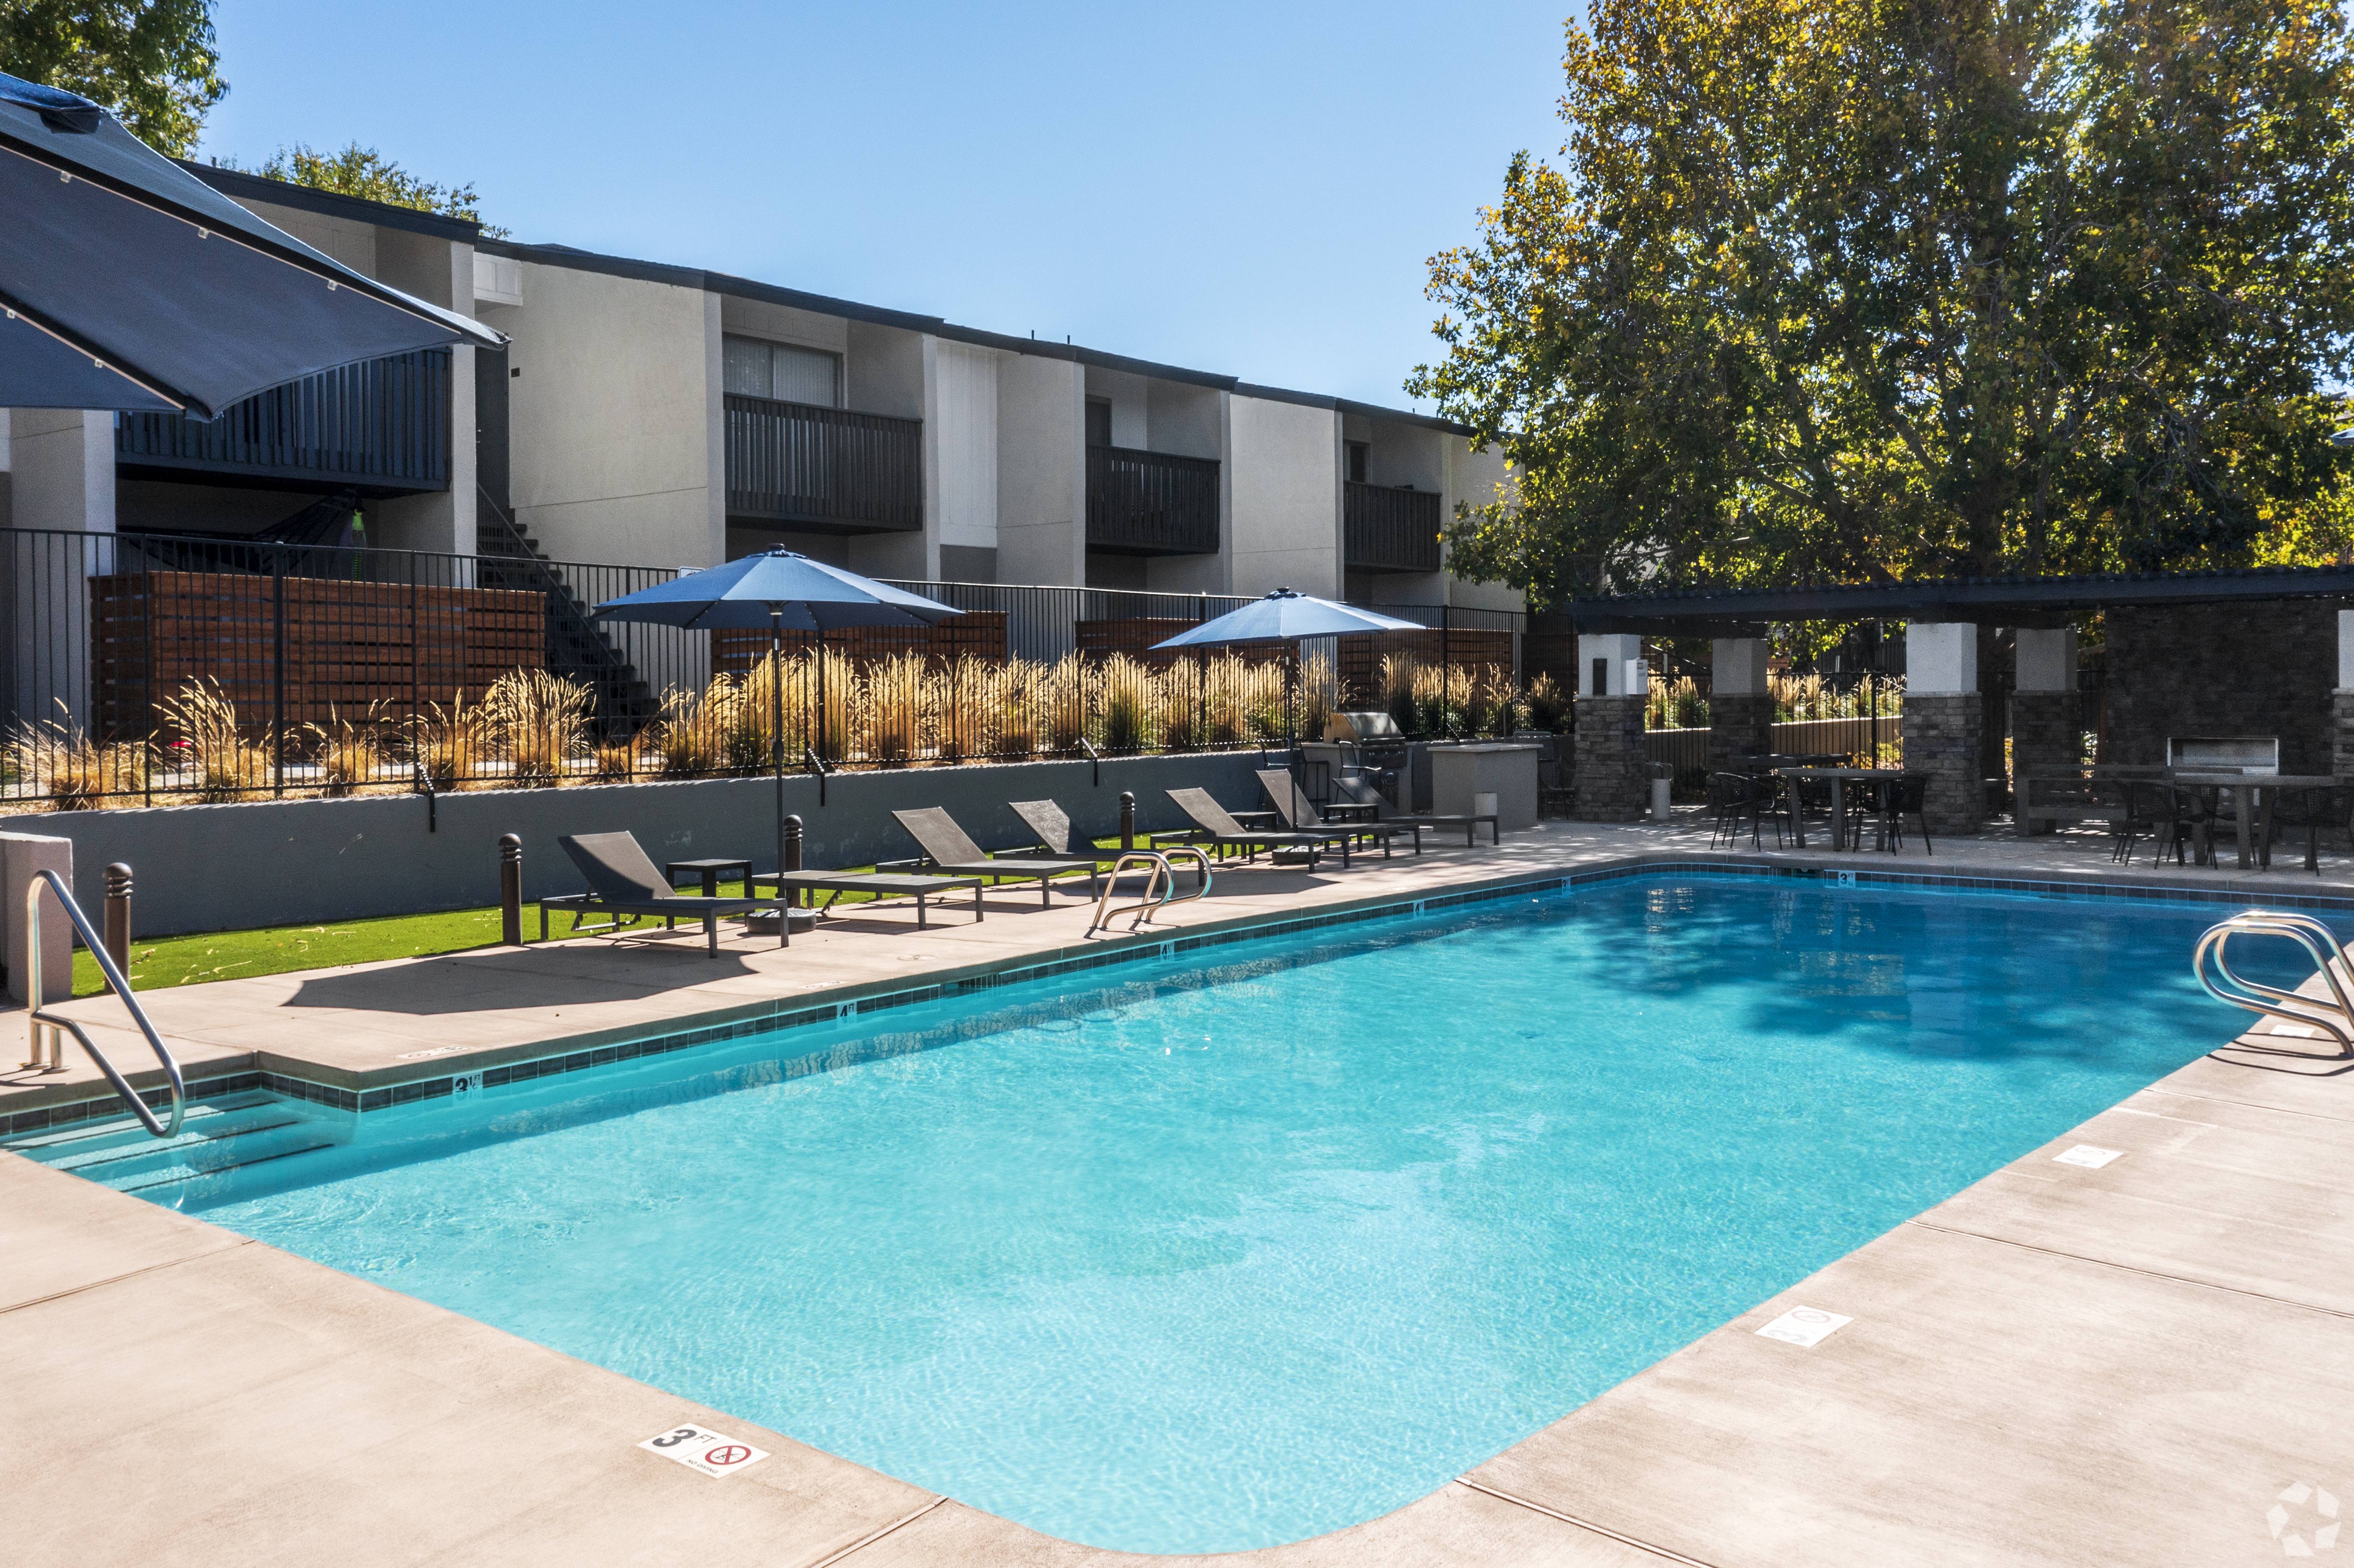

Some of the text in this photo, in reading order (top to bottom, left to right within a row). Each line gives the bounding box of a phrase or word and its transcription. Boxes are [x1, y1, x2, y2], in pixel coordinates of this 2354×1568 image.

[848, 1003, 855, 1011] FT
[652, 1429, 717, 1447] 3 FT
[697, 1463, 719, 1474] DIVING
